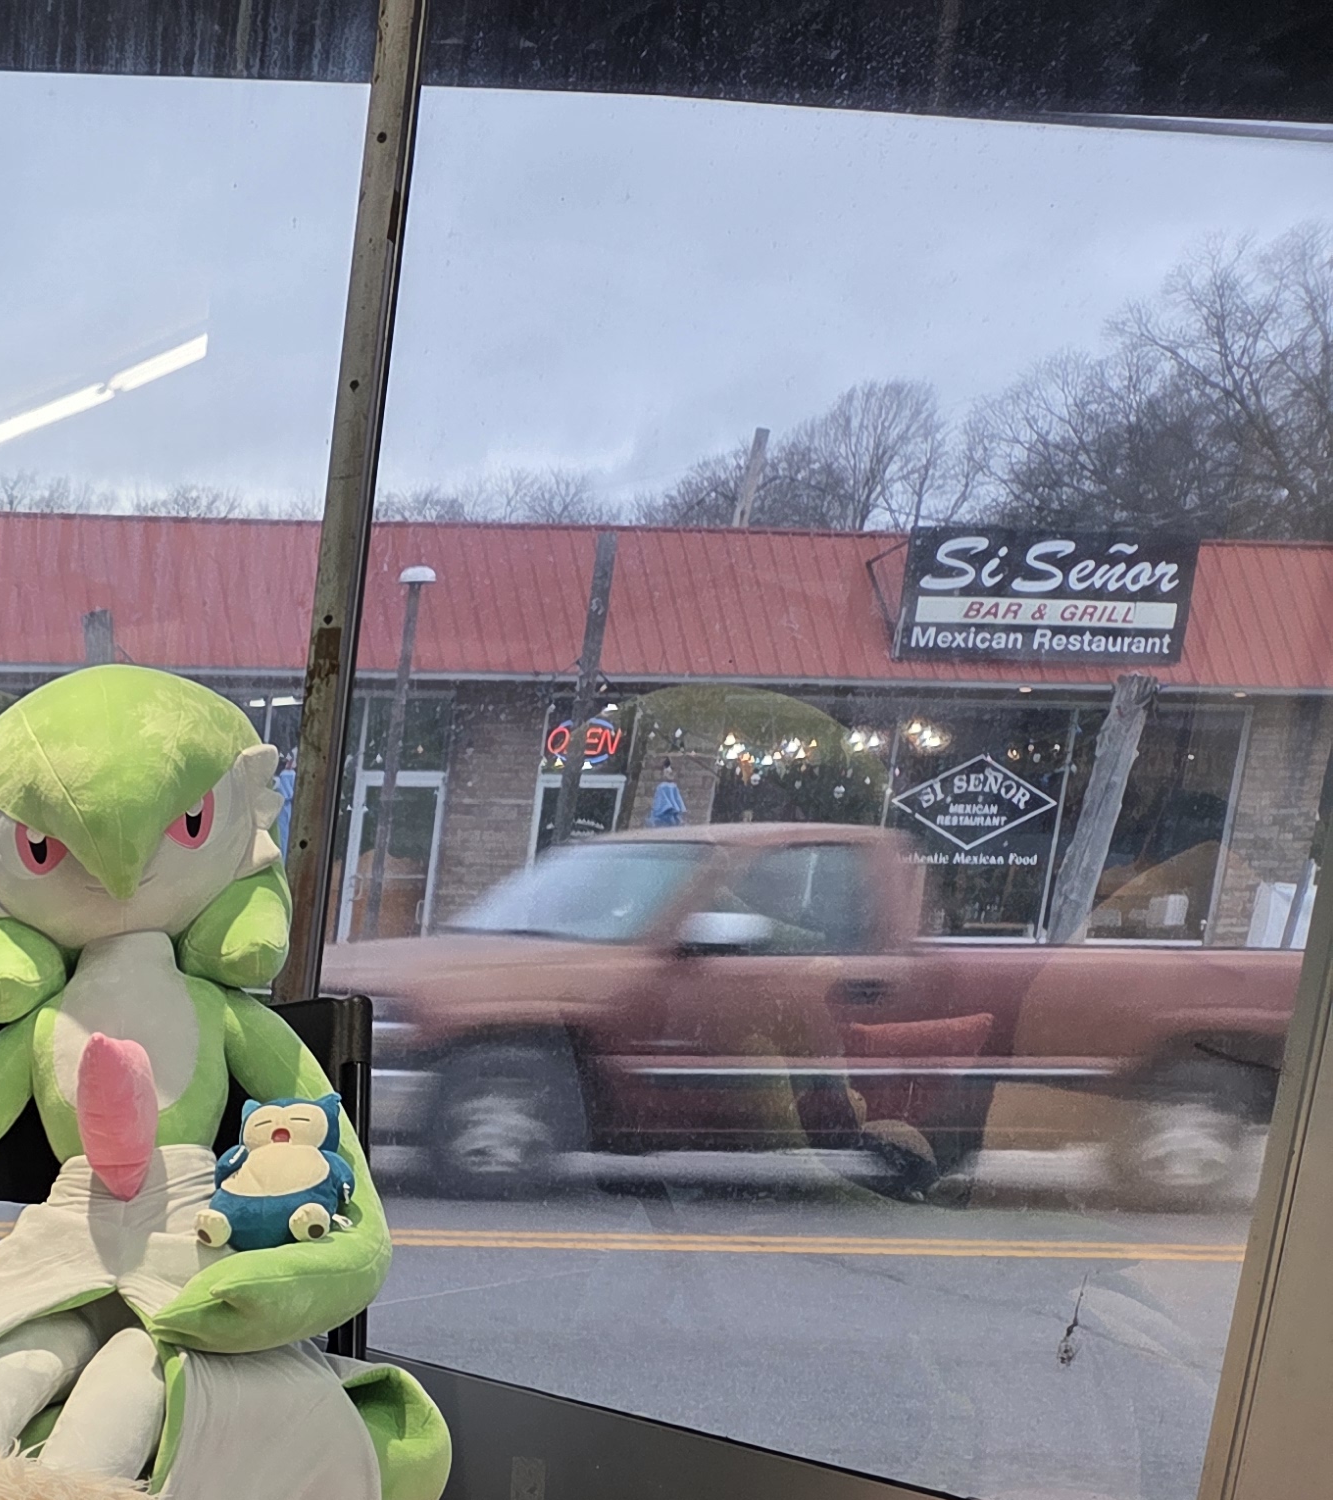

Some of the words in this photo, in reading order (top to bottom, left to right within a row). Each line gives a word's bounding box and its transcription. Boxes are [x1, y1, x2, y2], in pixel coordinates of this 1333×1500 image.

[919, 536, 1009, 591] Si
[1011, 539, 1180, 593] Señor
[963, 600, 1021, 620] BAR
[1030, 603, 1047, 620] &
[1060, 604, 1135, 625] GRILL
[910, 626, 1023, 651] Mexican
[1032, 628, 1172, 655] Restaurant
[547, 725, 623, 755] OEN
[936, 815, 1008, 827] RESTAURANT
[948, 803, 999, 814] MEXICAN
[953, 852, 1004, 865] Mexican
[1008, 853, 1038, 866] Food
